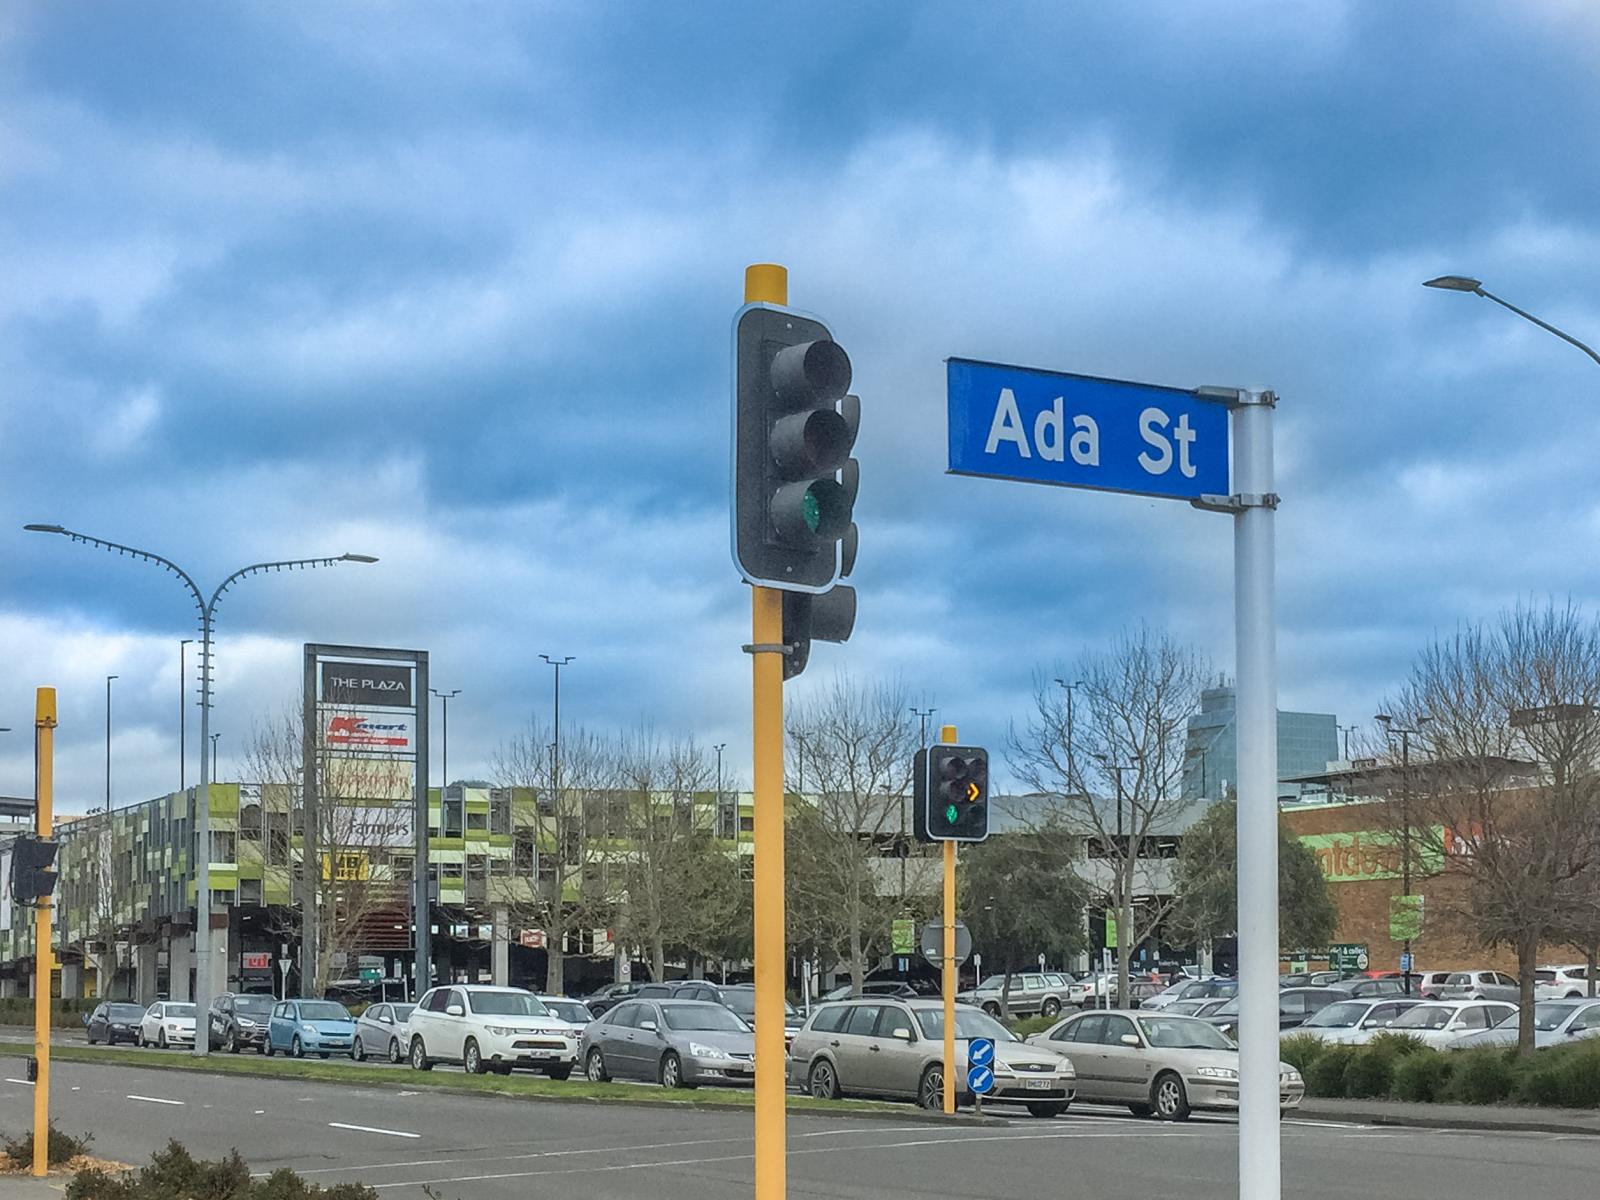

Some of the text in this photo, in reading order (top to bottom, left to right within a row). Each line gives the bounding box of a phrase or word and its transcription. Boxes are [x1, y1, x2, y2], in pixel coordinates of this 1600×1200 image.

[985, 387, 1197, 478] Ada St
[330, 677, 406, 691] THE PLAZA
